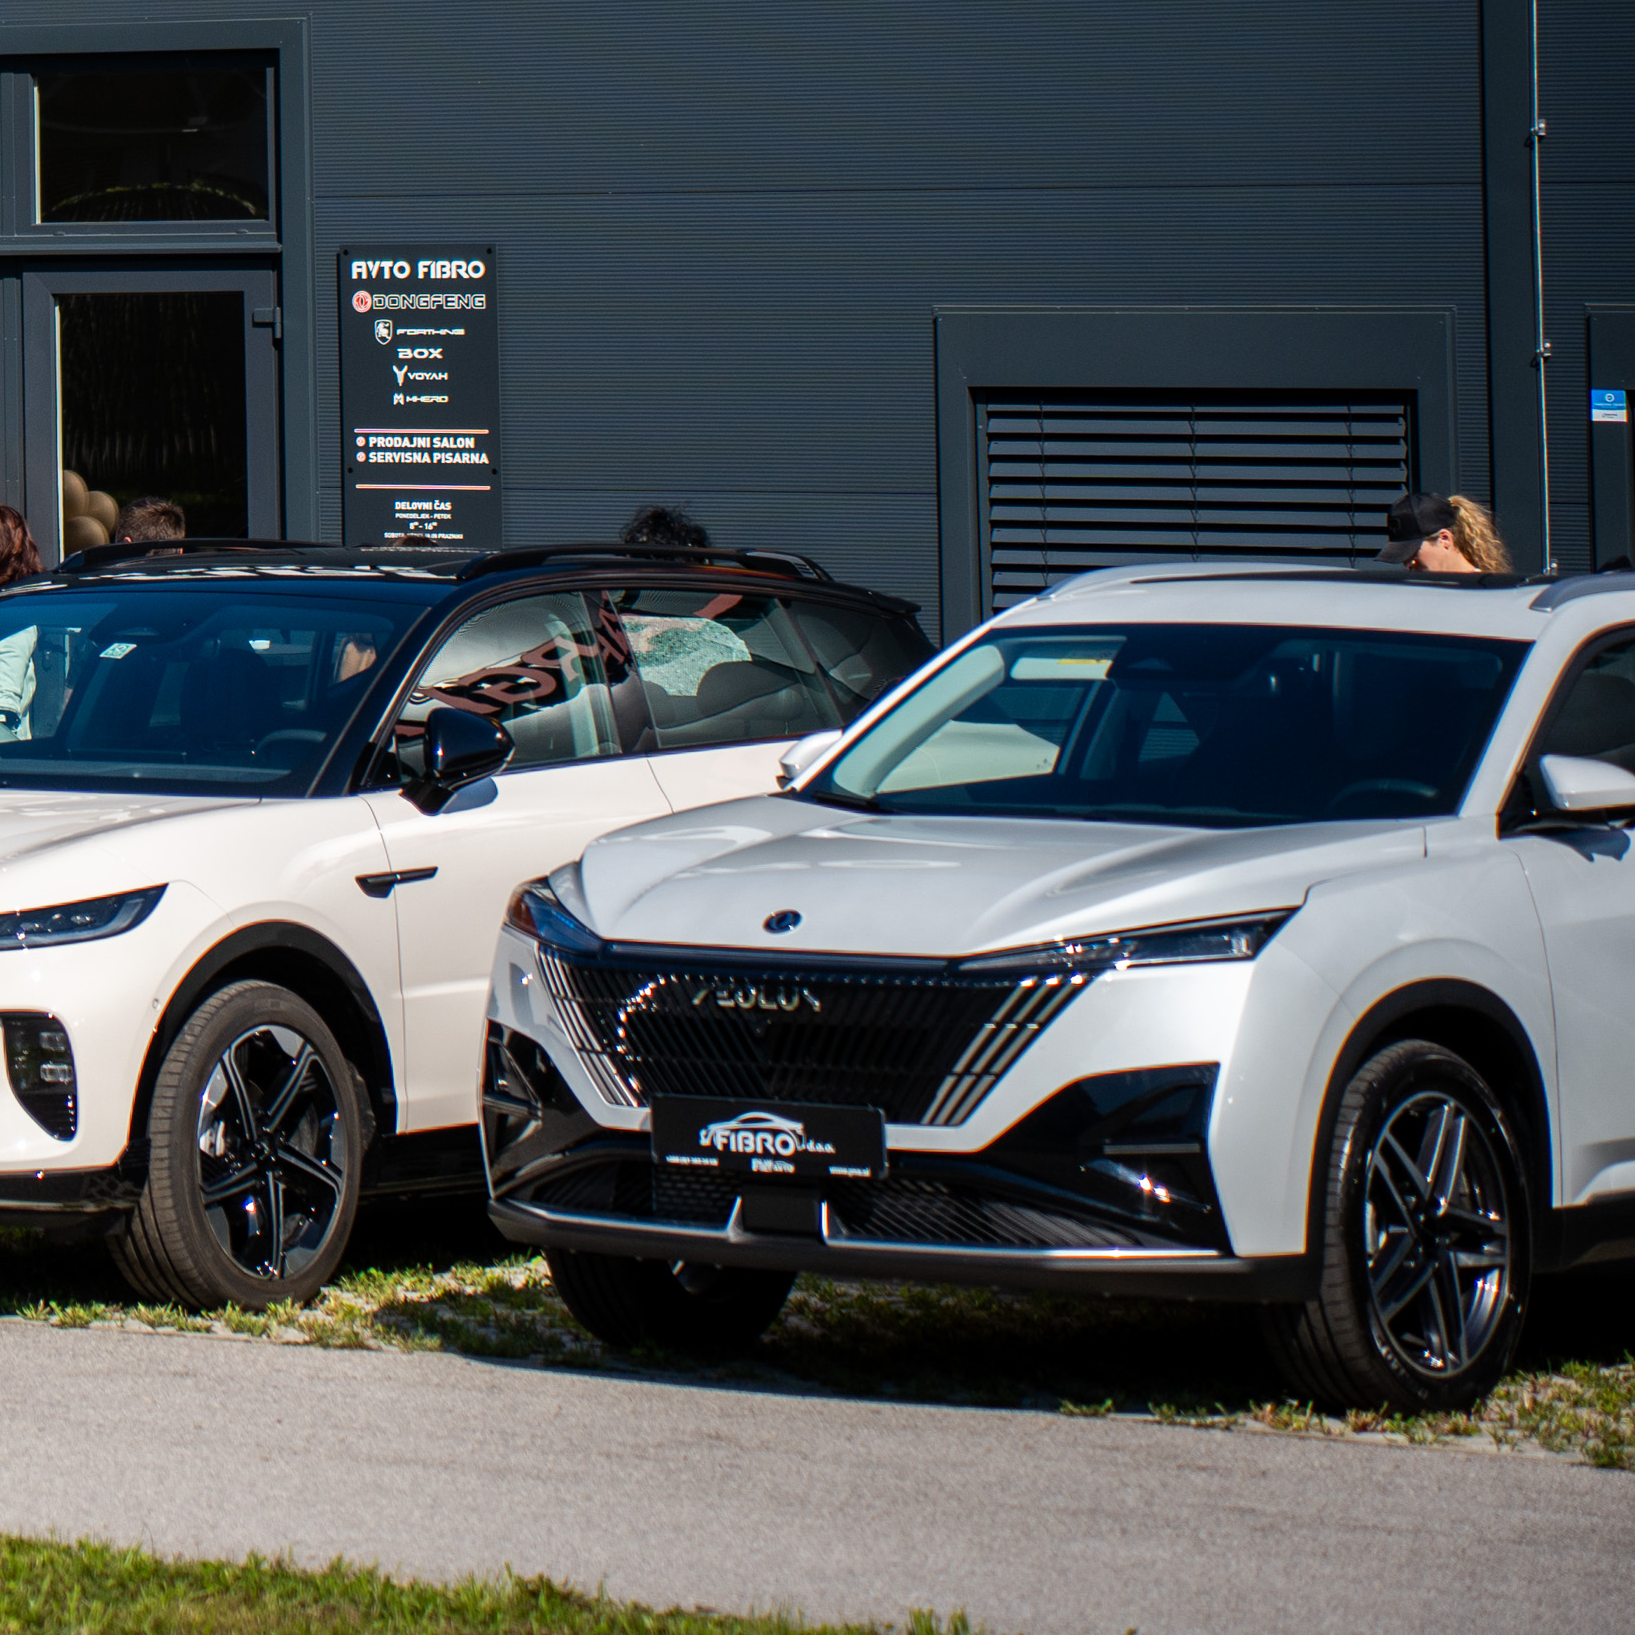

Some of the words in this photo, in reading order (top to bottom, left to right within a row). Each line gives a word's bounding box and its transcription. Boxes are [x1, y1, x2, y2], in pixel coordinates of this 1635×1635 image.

[351, 260, 411, 280] AVTO
[417, 260, 486, 280] FIBRO
[372, 294, 487, 310] DONGFENG
[397, 348, 443, 360] BOX
[407, 372, 449, 381] VOYAH
[368, 436, 431, 449] PRODAJNI
[432, 437, 476, 450] SALON
[368, 451, 431, 464] SERVISNA
[432, 452, 490, 465] PISARNA
[394, 502, 432, 511] DELOVNI
[433, 499, 452, 511] ČAS
[713, 1129, 797, 1157] FIBRO
